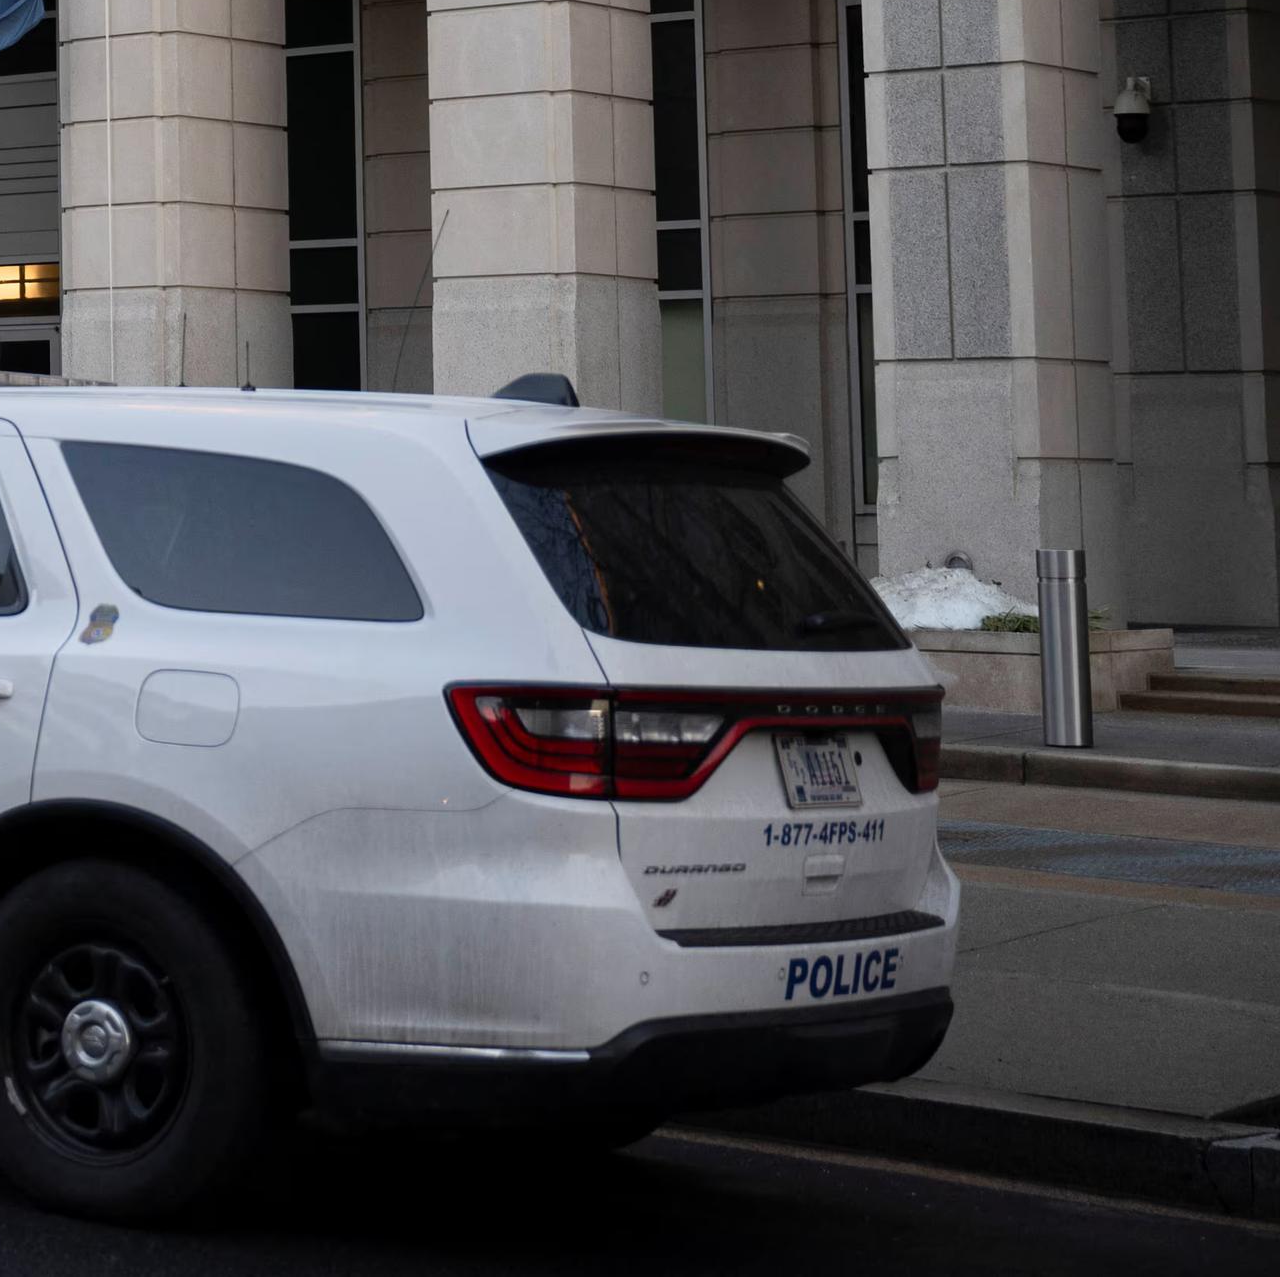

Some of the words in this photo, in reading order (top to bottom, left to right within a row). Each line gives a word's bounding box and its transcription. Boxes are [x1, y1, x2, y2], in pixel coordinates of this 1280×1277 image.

[763, 819, 884, 847] 1-877-4FPS-411
[644, 863, 746, 874] DURANGO
[785, 948, 899, 1000] POLICE
